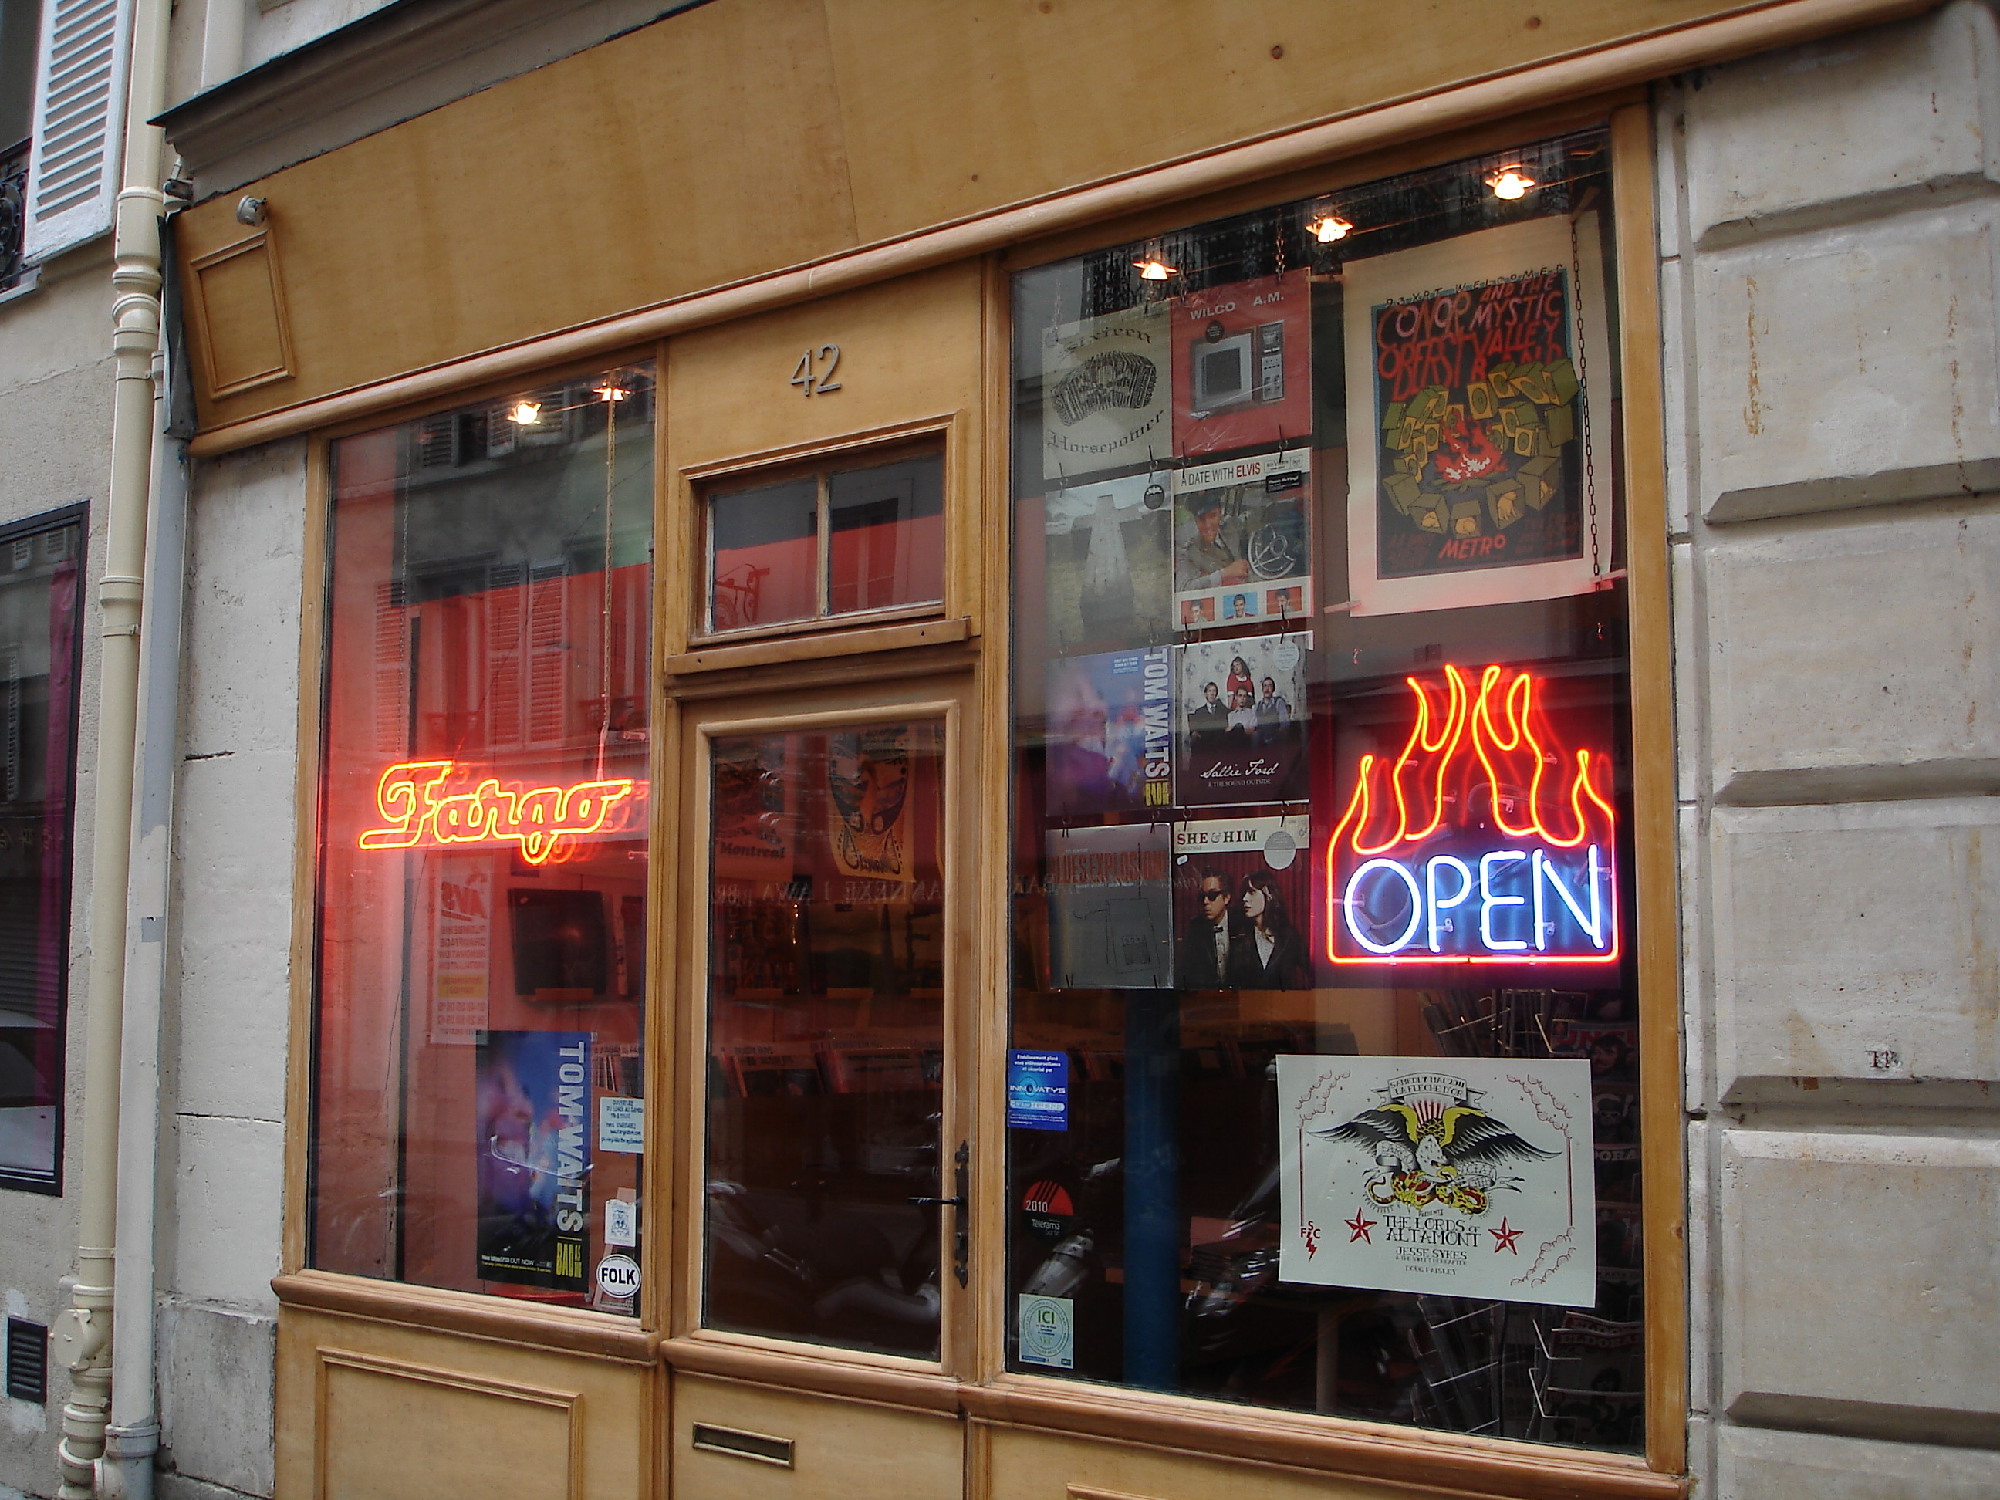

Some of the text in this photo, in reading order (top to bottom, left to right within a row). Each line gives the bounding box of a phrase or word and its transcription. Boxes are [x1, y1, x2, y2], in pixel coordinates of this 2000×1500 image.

[1479, 273, 1560, 303] AND THE
[1190, 291, 1285, 321] WILCO A.M.
[1469, 290, 1563, 331] MYSTIC
[1376, 290, 1472, 349] CONOR
[1475, 318, 1560, 360] VALLEY
[789, 343, 842, 398] 42
[1181, 474, 1188, 487] A
[1188, 470, 1210, 486] DATE
[1211, 466, 1234, 482] WITH
[1236, 461, 1261, 478] ELVIS
[1438, 534, 1506, 560] METRO
[1144, 648, 1171, 779] TOM WAITS
[1200, 757, 1280, 779] Sallie Ford
[358, 759, 633, 865] Fargo
[720, 841, 785, 859] Montreal
[1177, 828, 1258, 846] SHE & HIM
[1343, 843, 1605, 954] OPEN
[556, 1041, 585, 1233] TOM WAITS
[1025, 1200, 1048, 1213] 2010
[1383, 1214, 1410, 1229] THE
[1415, 1217, 1466, 1232] LORDS
[1386, 1228, 1482, 1247] ALTAMONT
[509, 1256, 520, 1265] OUT
[521, 1258, 534, 1267] NOW
[1396, 1246, 1467, 1261] JESSE SYKES
[601, 1267, 636, 1286] FOLK
[1037, 1310, 1055, 1324] ICI
